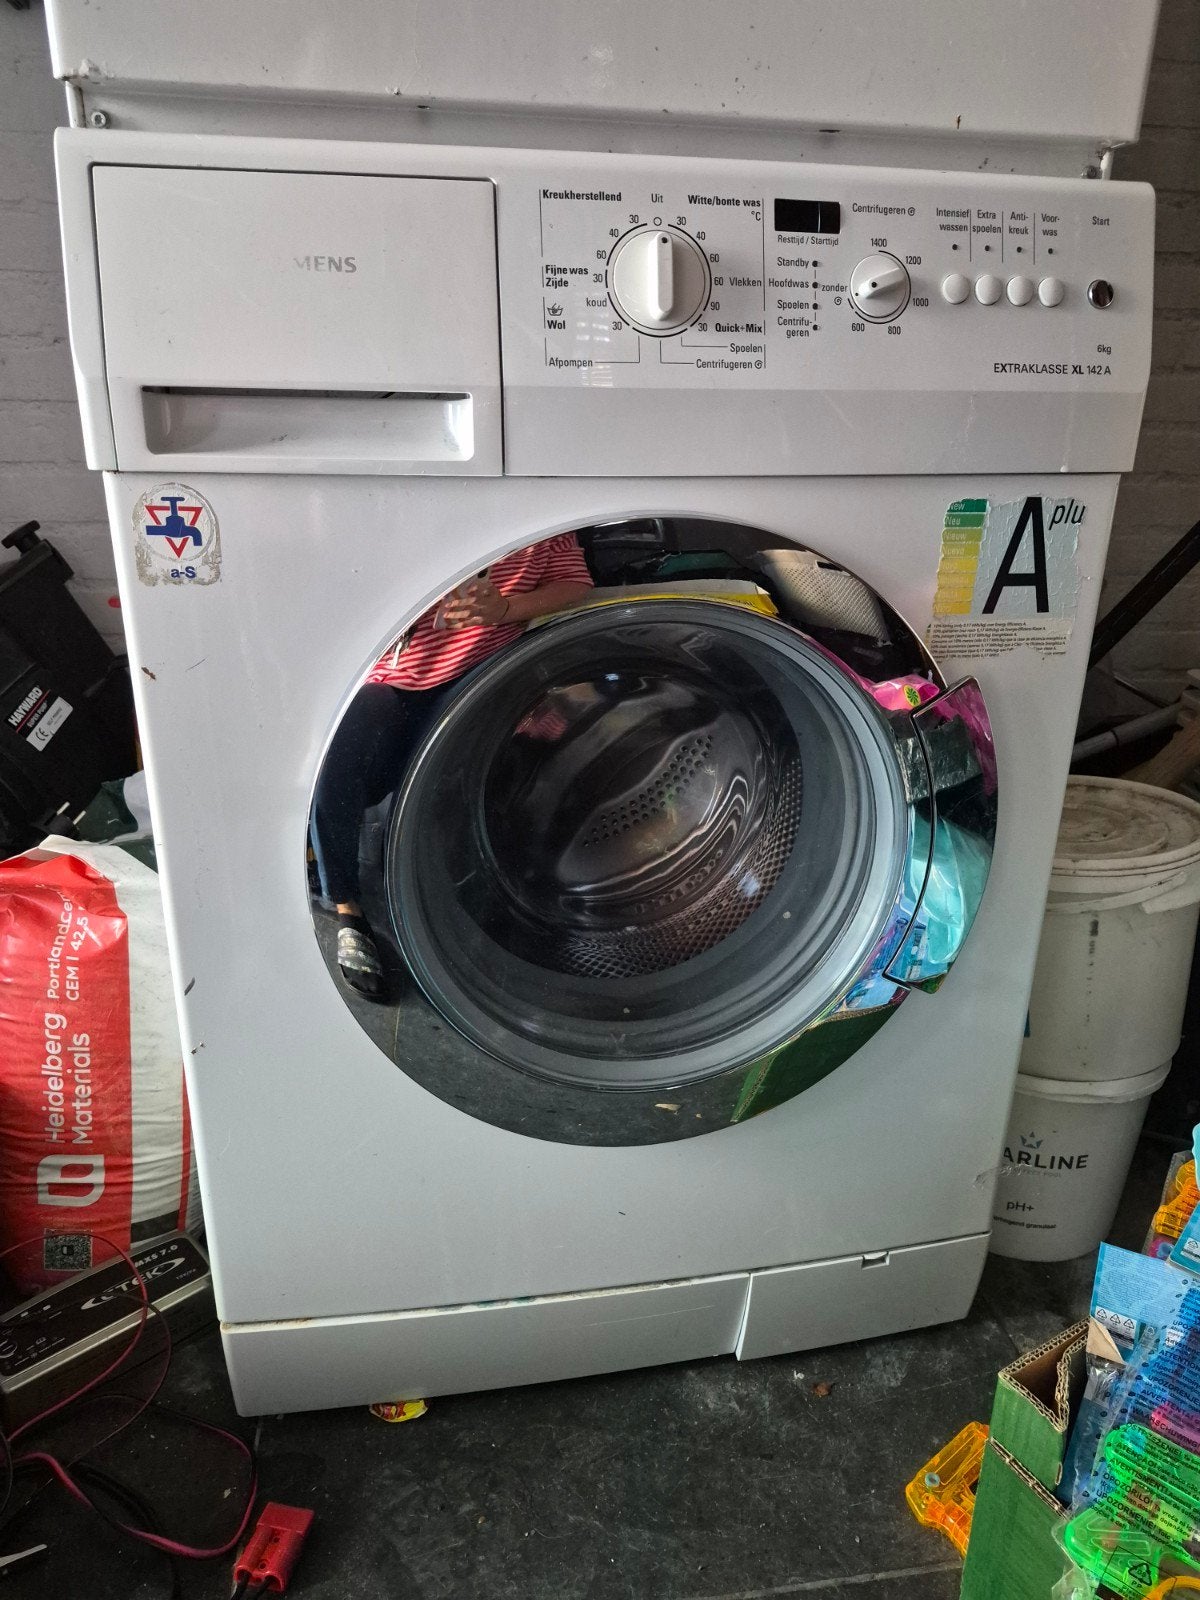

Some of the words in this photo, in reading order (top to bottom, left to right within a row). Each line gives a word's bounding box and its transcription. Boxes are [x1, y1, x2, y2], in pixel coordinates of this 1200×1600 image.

[542, 189, 622, 202] Kreukherstellend
[651, 194, 664, 203] Uit
[687, 195, 741, 207] Witte/bonte
[743, 199, 761, 207] was
[852, 203, 906, 216] Centrifugeren
[936, 207, 970, 218] Intensief
[629, 214, 639, 224] 30
[977, 210, 997, 220] Extra
[1010, 211, 1029, 221] Anti-
[1041, 213, 1060, 223] Voor-
[676, 216, 687, 226] 30
[1092, 216, 1110, 226] Start
[939, 223, 968, 232] wassen
[972, 224, 1002, 234] spoelen
[1008, 226, 1029, 235] kreuk
[608, 228, 619, 238] 40
[696, 232, 706, 241] 40
[1042, 229, 1057, 237] was
[777, 235, 805, 245] Resttijd
[810, 236, 839, 246] Starttijd
[870, 238, 887, 248] 1400
[596, 249, 607, 260] 60
[709, 253, 720, 263] 60
[777, 257, 810, 268] Standby
[905, 256, 921, 265] 1200
[545, 265, 568, 276] Fijne
[569, 267, 589, 275] was
[545, 278, 569, 288] Zijde
[592, 274, 603, 283] 30
[714, 277, 724, 286] 60
[729, 278, 762, 287] Vlekken
[768, 279, 810, 289] Hoofdwas
[821, 284, 848, 292] zonder
[586, 298, 607, 307] koud
[710, 301, 720, 311] 90
[777, 300, 809, 310] Spoelen
[912, 298, 929, 307] 1000
[547, 320, 566, 330] Wol
[612, 321, 622, 331] 30
[777, 317, 812, 326] Centrifu-
[698, 323, 708, 332] 30
[715, 323, 762, 334] Quick+Mix
[851, 323, 865, 332] 600
[887, 326, 901, 335] 800
[786, 329, 809, 338] geren
[730, 344, 763, 354] Spoelen
[1097, 345, 1112, 354] 6kg
[548, 357, 593, 368] Afpompen
[696, 359, 753, 370] Centrifugeren
[993, 363, 1068, 374] EXTRAKLASSE
[1071, 364, 1084, 374] XL
[1049, 499, 1085, 530] plu
[945, 516, 961, 526] Neu
[982, 496, 1049, 614] A
[170, 566, 196, 579] a-S
[7, 686, 43, 726] HAYWARD
[65, 965, 80, 1001] CEM
[41, 1012, 67, 1144] Heidelberg
[66, 1032, 93, 1144] Materials
[1006, 1201, 1035, 1211] pH+
[134, 1254, 158, 1268] MXS
[159, 1244, 178, 1256] 7.0
